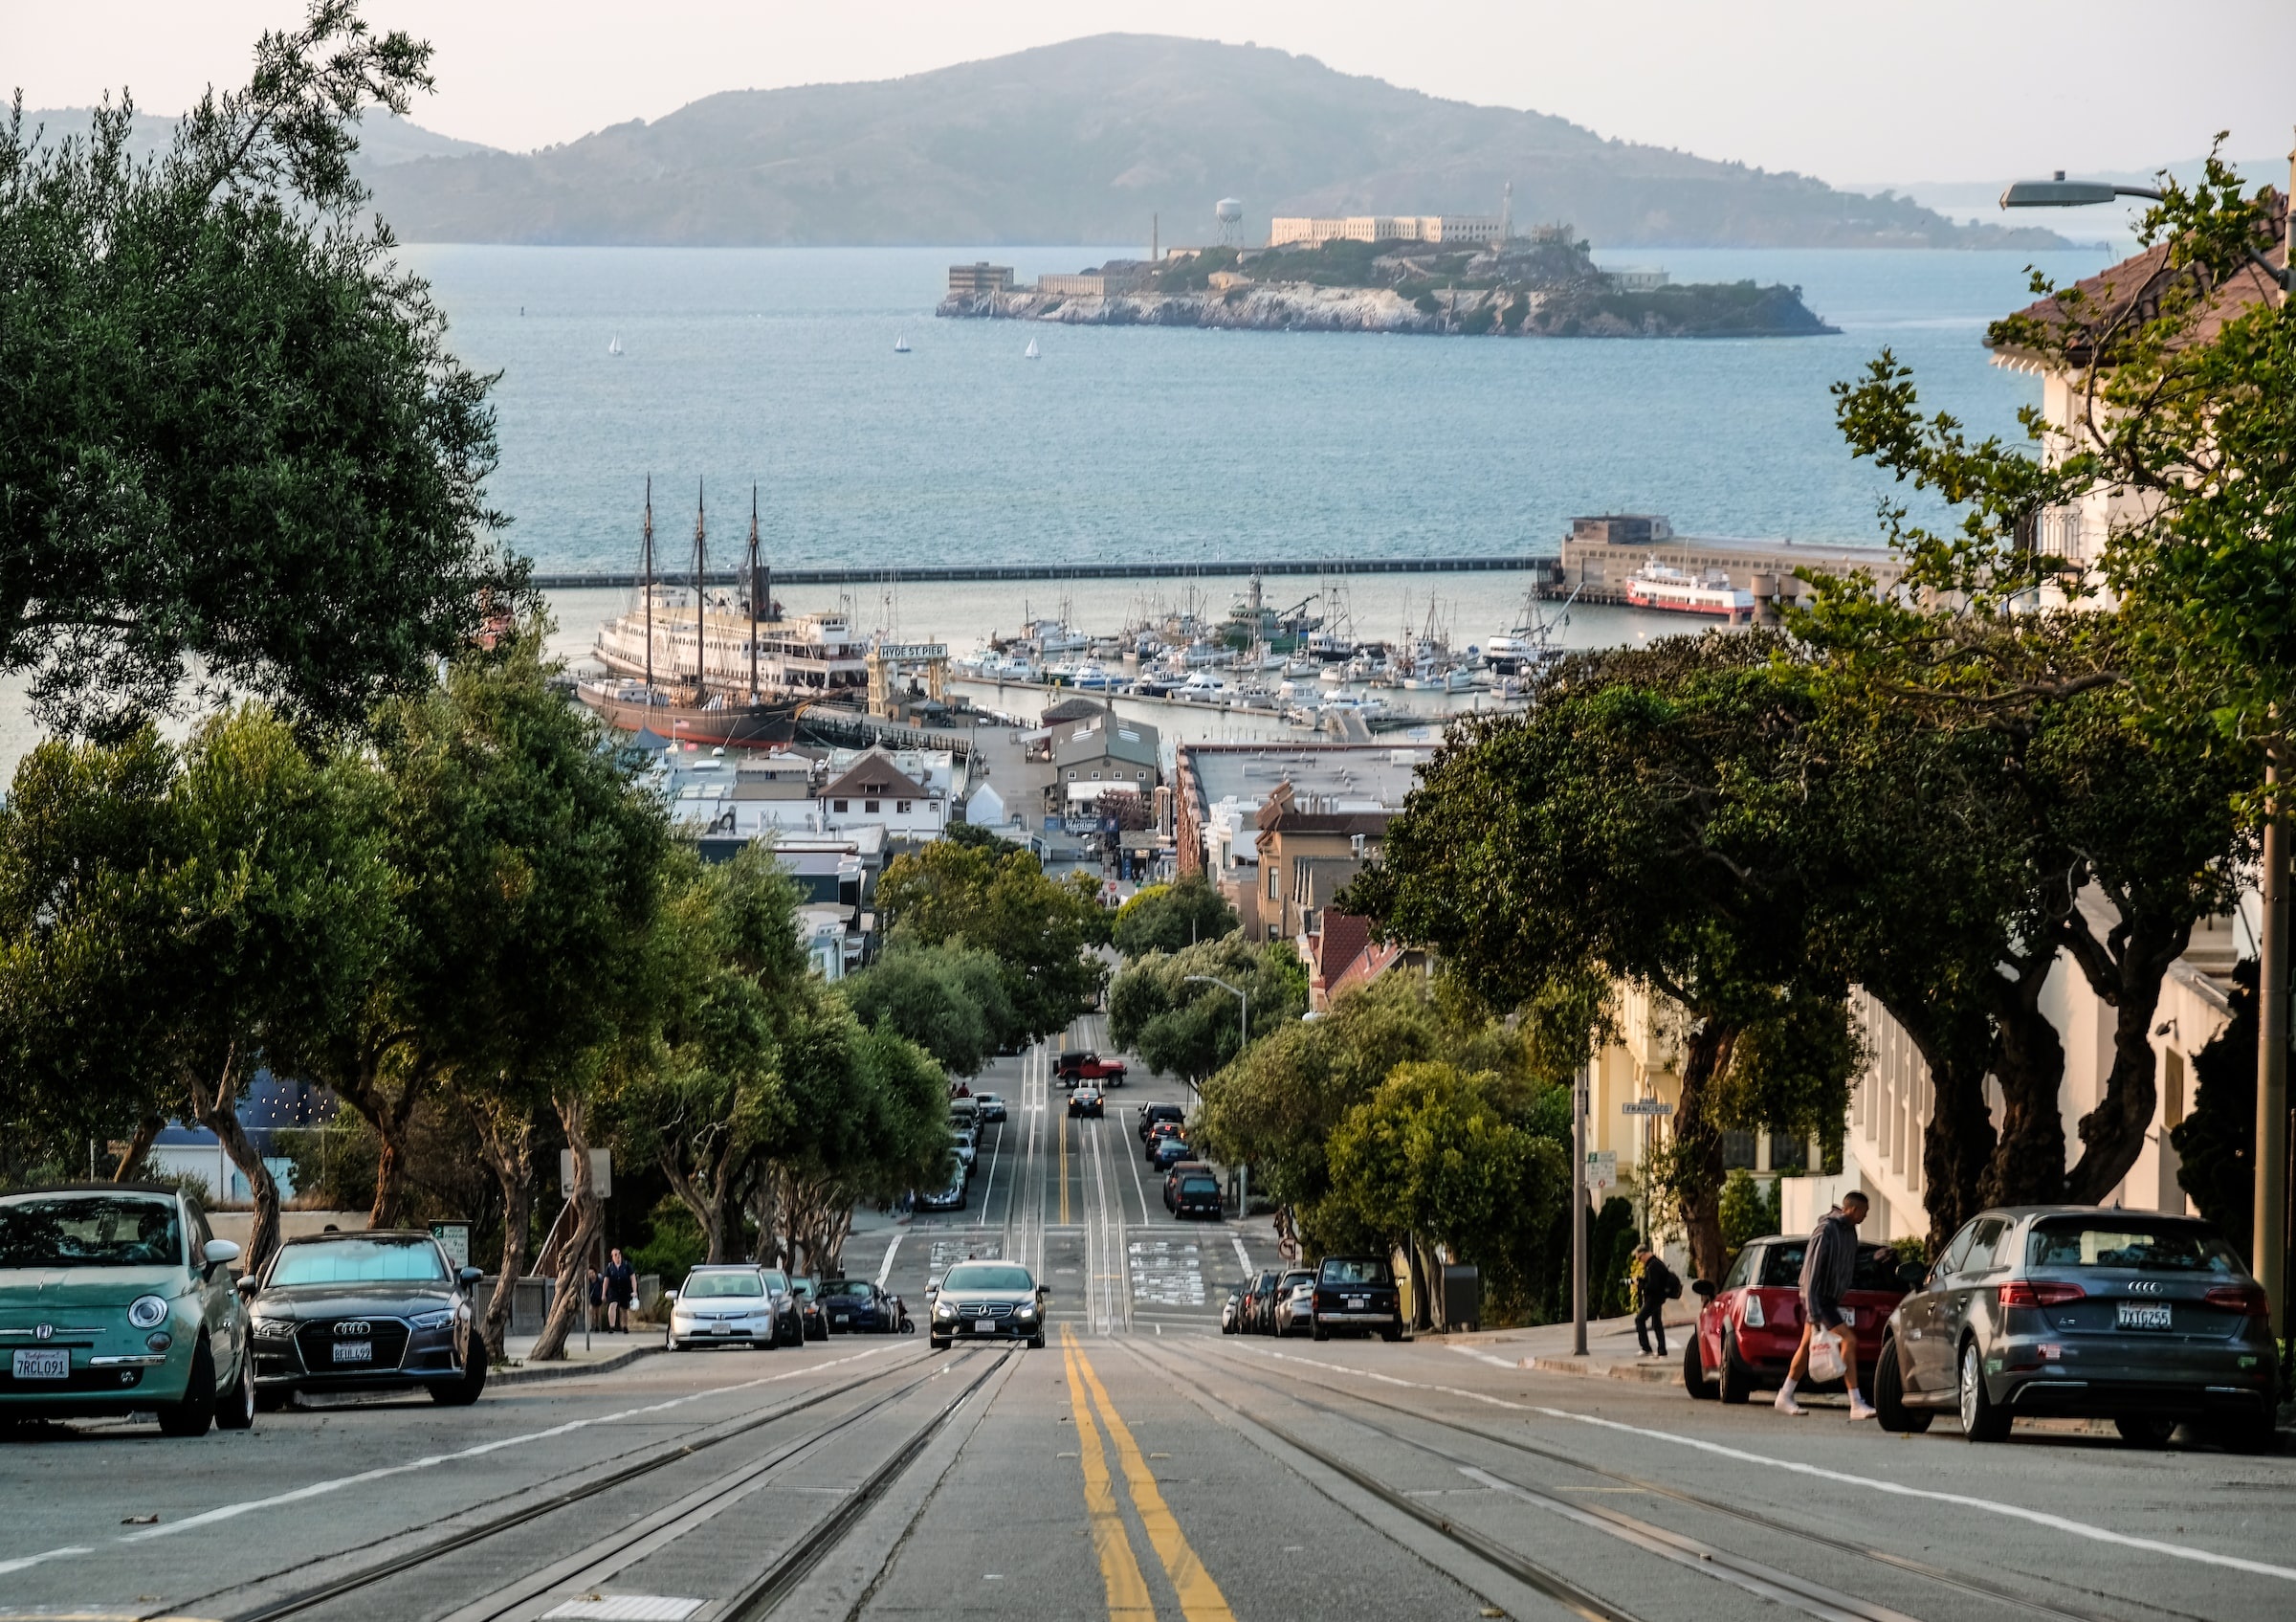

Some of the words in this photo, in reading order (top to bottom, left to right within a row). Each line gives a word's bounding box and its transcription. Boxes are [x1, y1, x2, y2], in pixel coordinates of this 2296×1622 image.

[882, 647, 906, 657] HYDE
[922, 645, 942, 655] PIER
[434, 1227, 442, 1237] 2
[17, 1360, 64, 1375] 7RCL091
